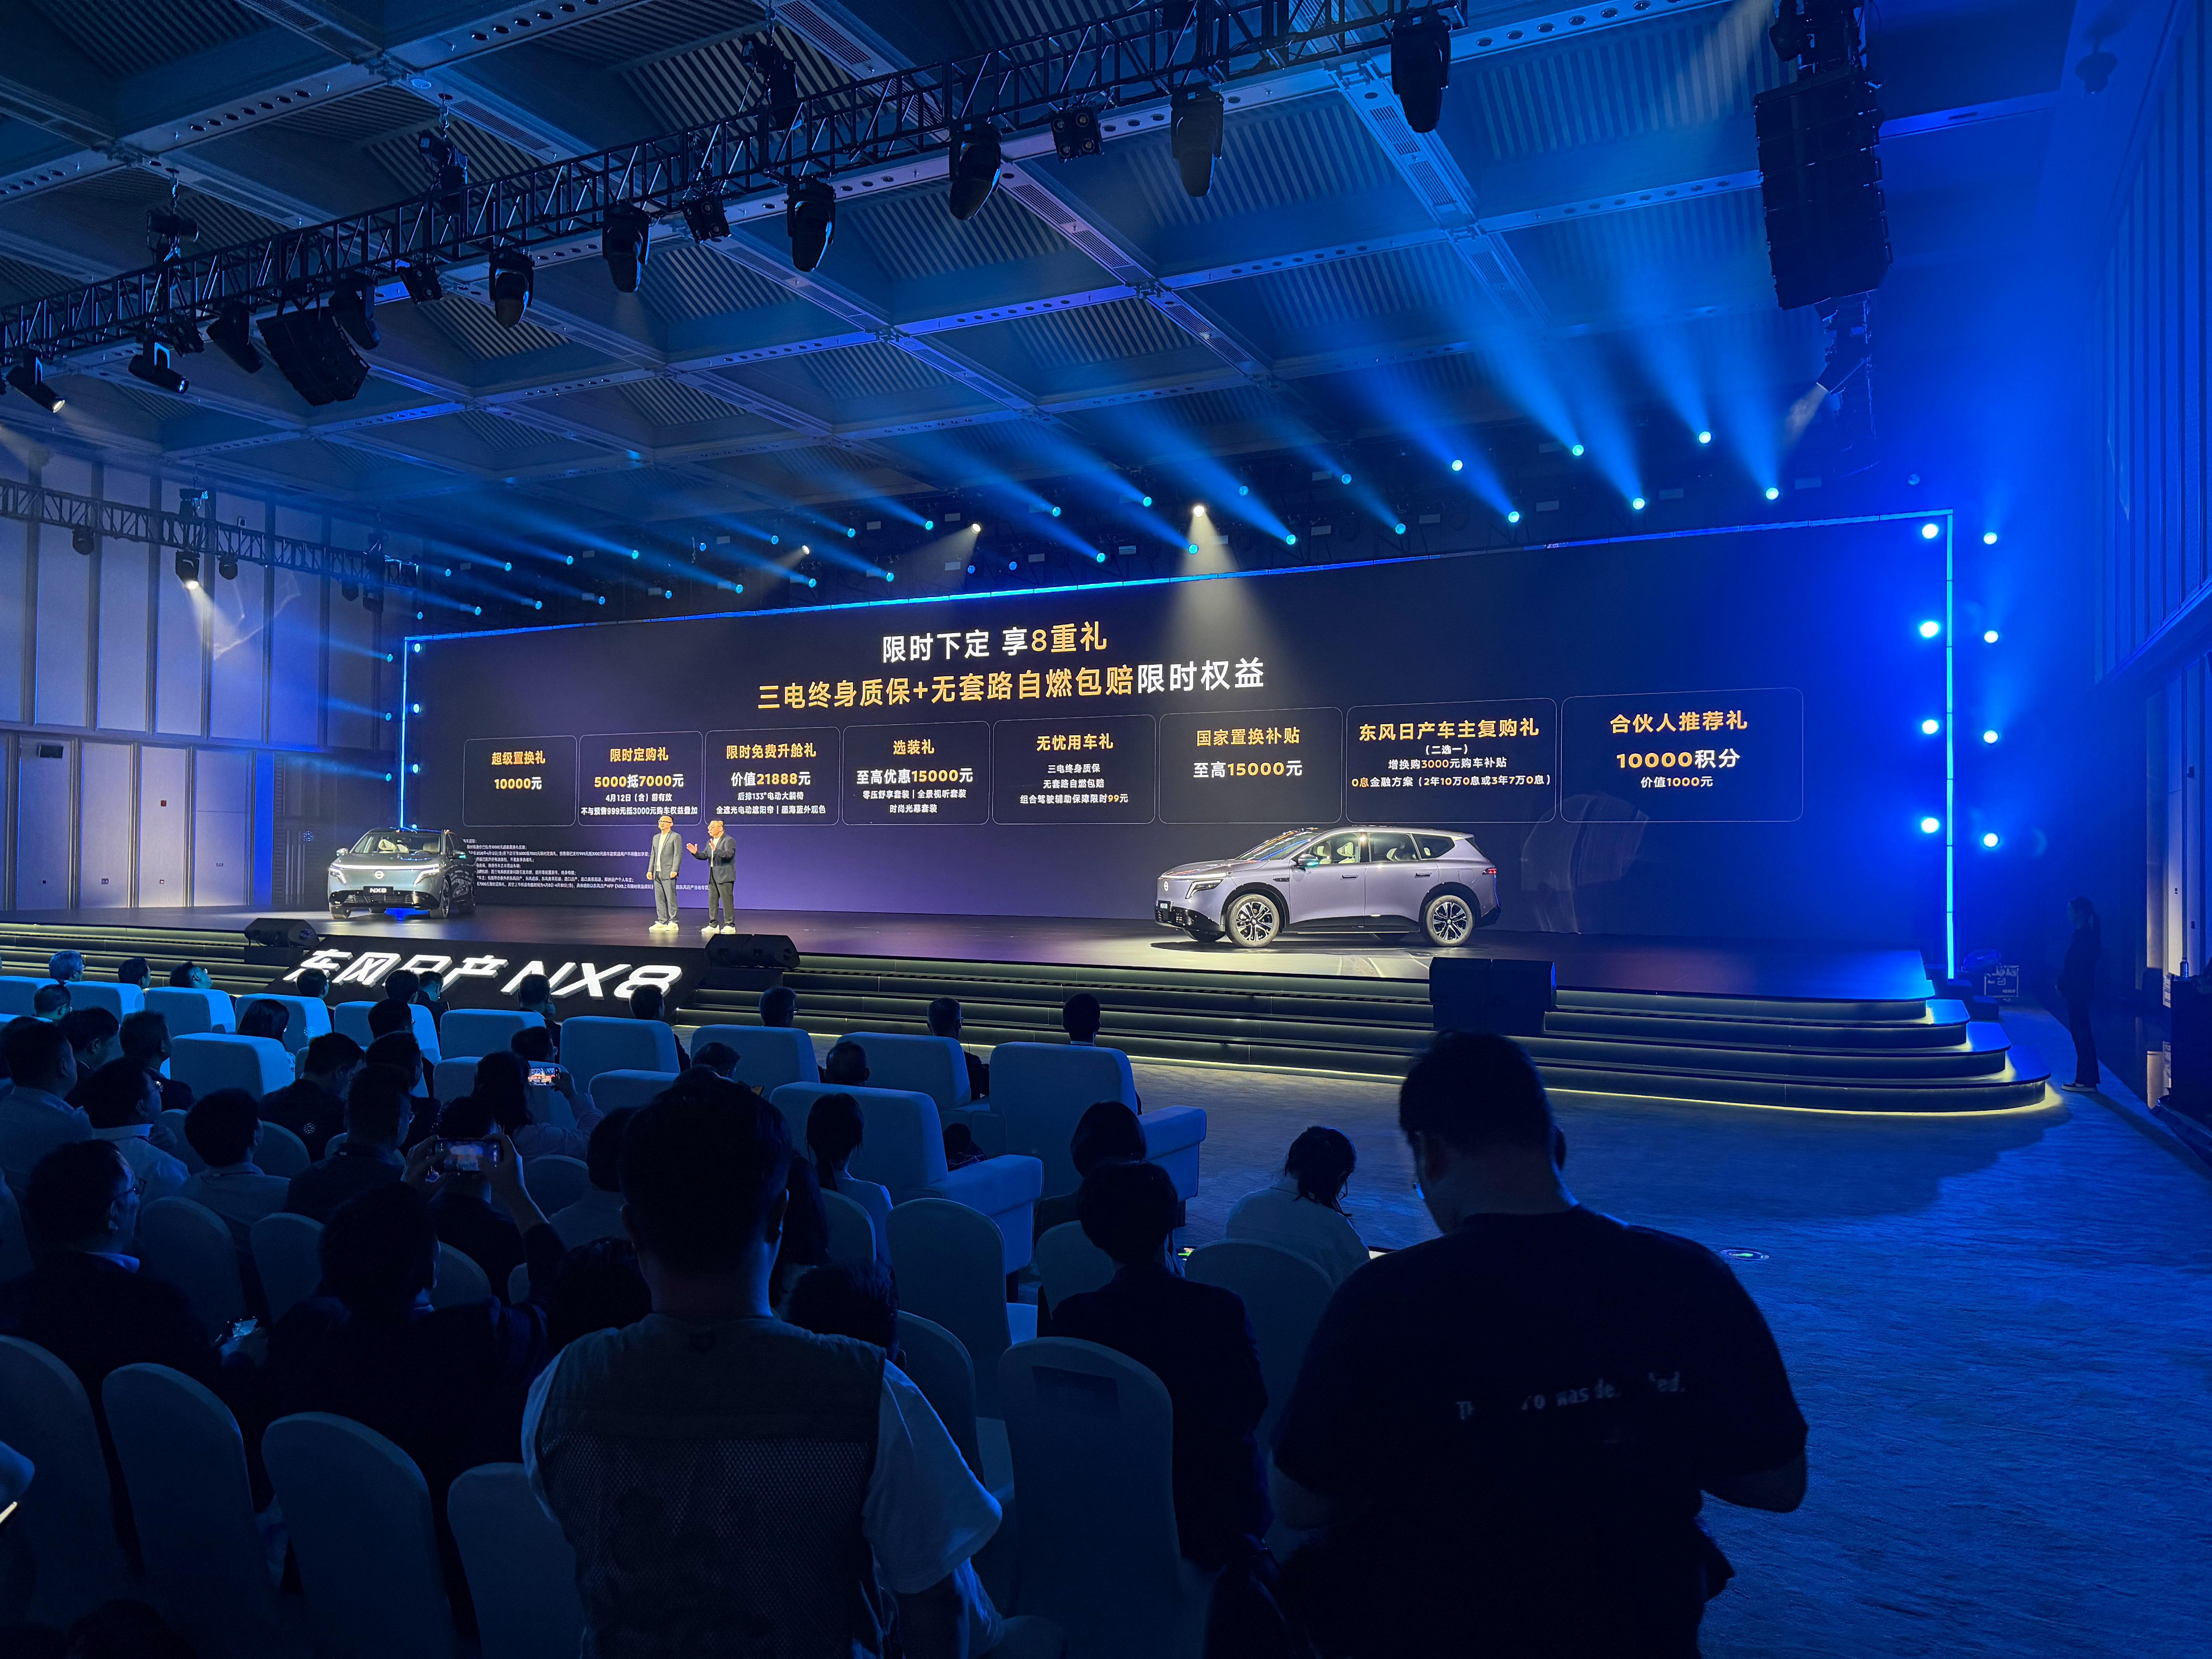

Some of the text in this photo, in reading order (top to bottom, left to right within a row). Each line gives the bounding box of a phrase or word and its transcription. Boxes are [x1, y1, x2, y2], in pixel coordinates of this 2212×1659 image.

[883, 621, 1107, 663] 限时下定 享8重礼
[758, 656, 1264, 709] 三电终身质保+无套路自燃包赔限时权益
[1359, 718, 1539, 741] 东风日产车主复购礼
[1610, 710, 1748, 733] 合伙人推荐礼
[1037, 733, 1113, 751] 无忧用车礼
[1197, 726, 1300, 747] 国家置换补贴
[610, 747, 669, 762] 限时定购礼
[726, 742, 816, 759] 限时免费升舱礼
[893, 738, 934, 755] 选装礼
[491, 750, 546, 765] 超级置换礼
[1388, 756, 1507, 770] 增换购3000元购车补贴
[1616, 748, 1740, 769] 10000积分
[856, 768, 973, 784] 至高优惠15000元
[1048, 763, 1101, 774] 三电终身质保
[1193, 760, 1302, 778] 至高15000元
[494, 776, 542, 790] 10000元
[594, 774, 684, 788] 5000抵7000元
[731, 771, 811, 787] 价值21888元
[1043, 778, 1104, 789] 无套路自燃包赔
[1640, 776, 1713, 788] 价值1000元
[1020, 793, 1128, 804] 组合驾驶辅助保障限时99元
